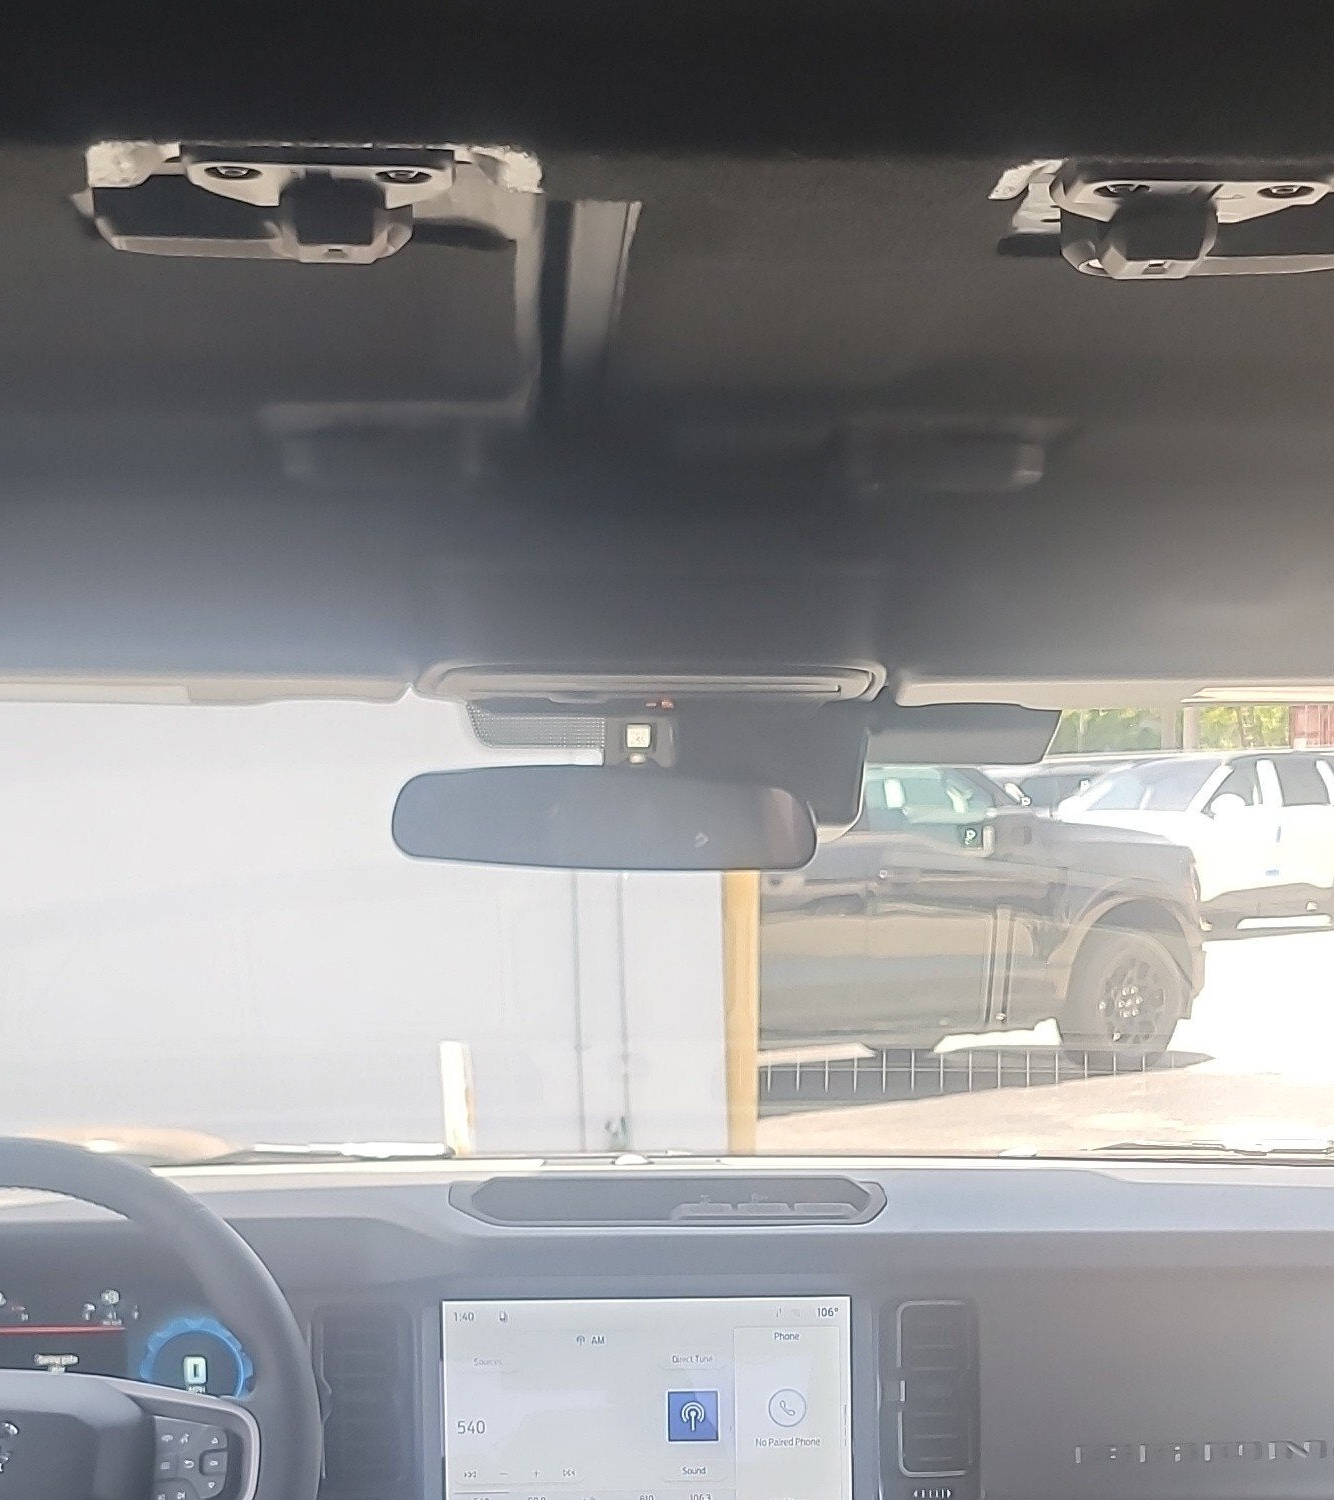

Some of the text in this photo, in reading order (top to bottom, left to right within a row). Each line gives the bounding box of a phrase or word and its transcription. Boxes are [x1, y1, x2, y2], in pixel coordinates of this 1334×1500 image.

[591, 1336, 606, 1345] AM
[774, 1332, 800, 1341] Phone
[457, 1421, 486, 1434] 540
[755, 1437, 820, 1447] No Paired Phone
[682, 1466, 706, 1475] Sound
